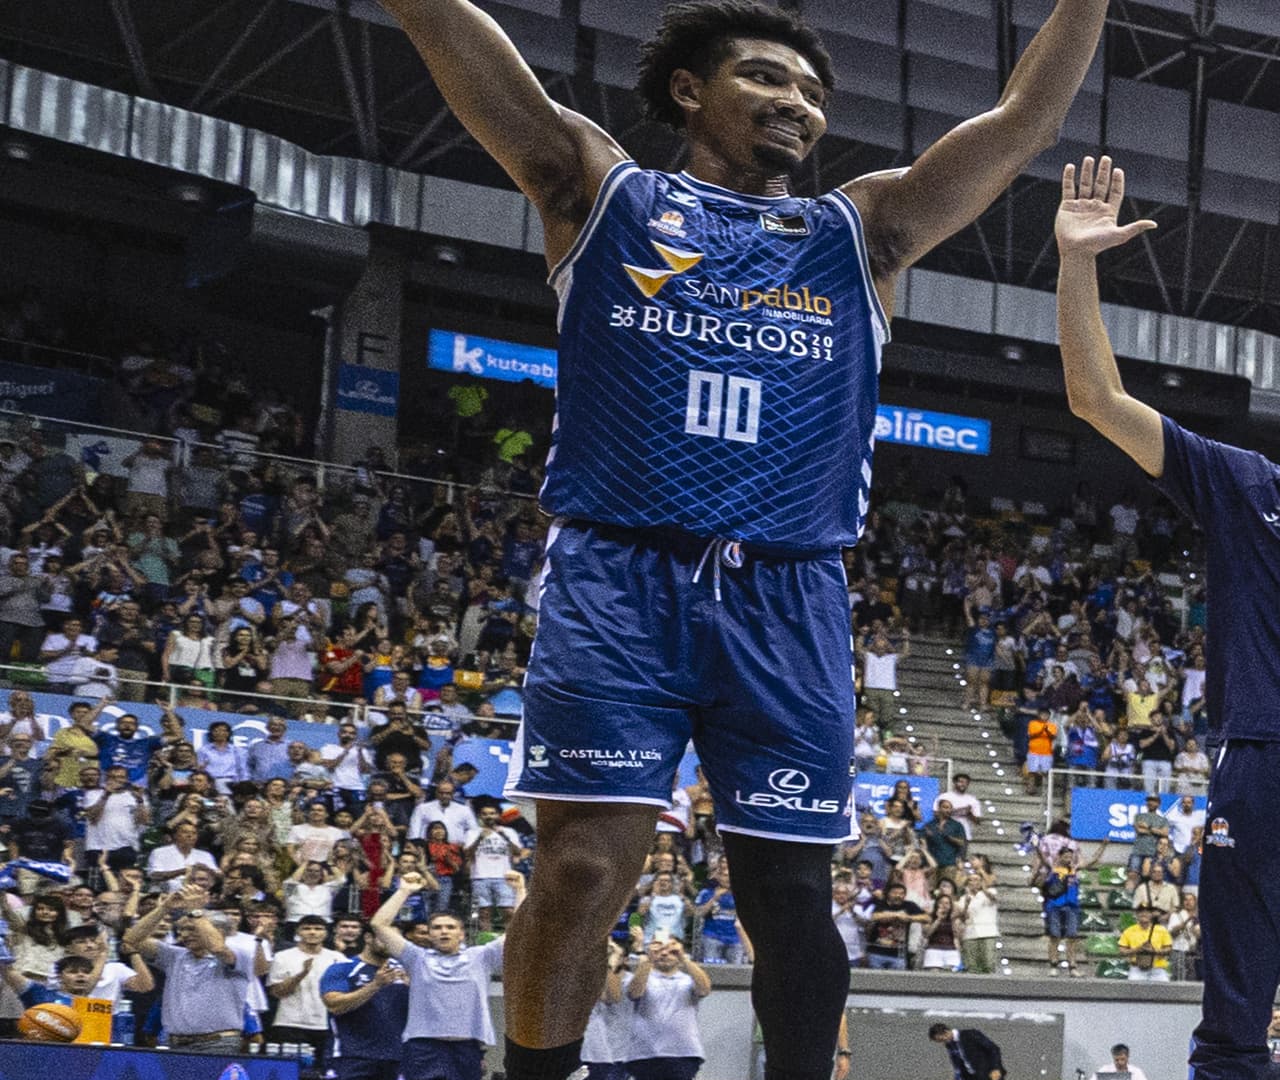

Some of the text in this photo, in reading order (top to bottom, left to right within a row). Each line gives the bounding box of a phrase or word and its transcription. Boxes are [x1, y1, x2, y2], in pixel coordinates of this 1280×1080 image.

[762, 307, 833, 326] INMOBILIARIA
[640, 305, 808, 356] BURGOS
[486, 353, 557, 378] kutxab
[685, 369, 762, 444] 00
[560, 749, 624, 760] CASTILLA
[735, 790, 839, 814] LEXUS
